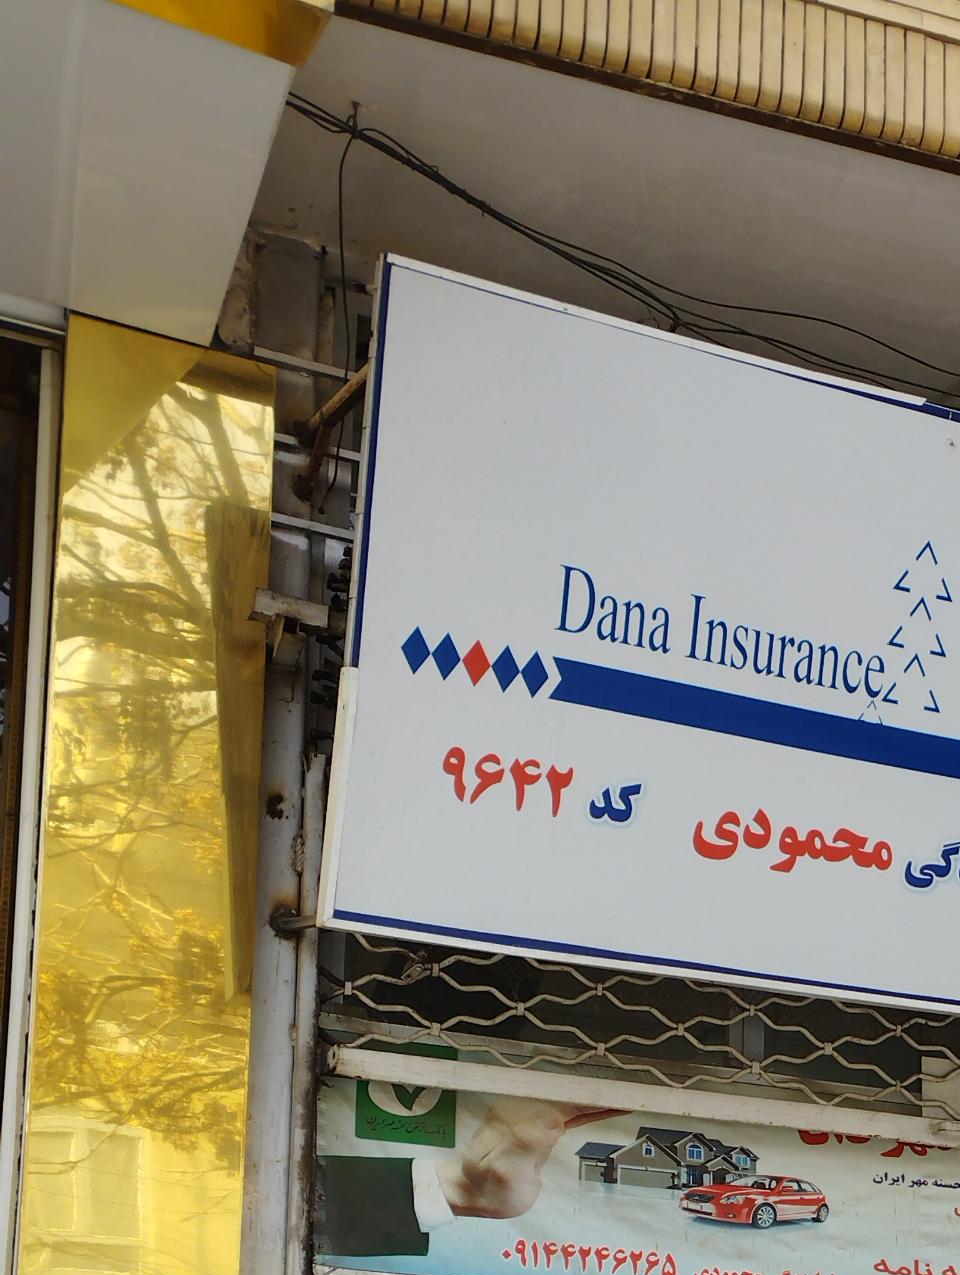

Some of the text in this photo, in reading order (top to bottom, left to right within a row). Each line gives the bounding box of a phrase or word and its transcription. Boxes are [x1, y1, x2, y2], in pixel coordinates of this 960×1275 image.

[555, 564, 885, 701] Dana Insurance
[441, 745, 574, 818] ۹۶۴۲
[587, 782, 642, 824] کد
[692, 808, 893, 873] محمودی
[872, 1171, 906, 1186] ایران
[908, 1176, 929, 1189] مهر
